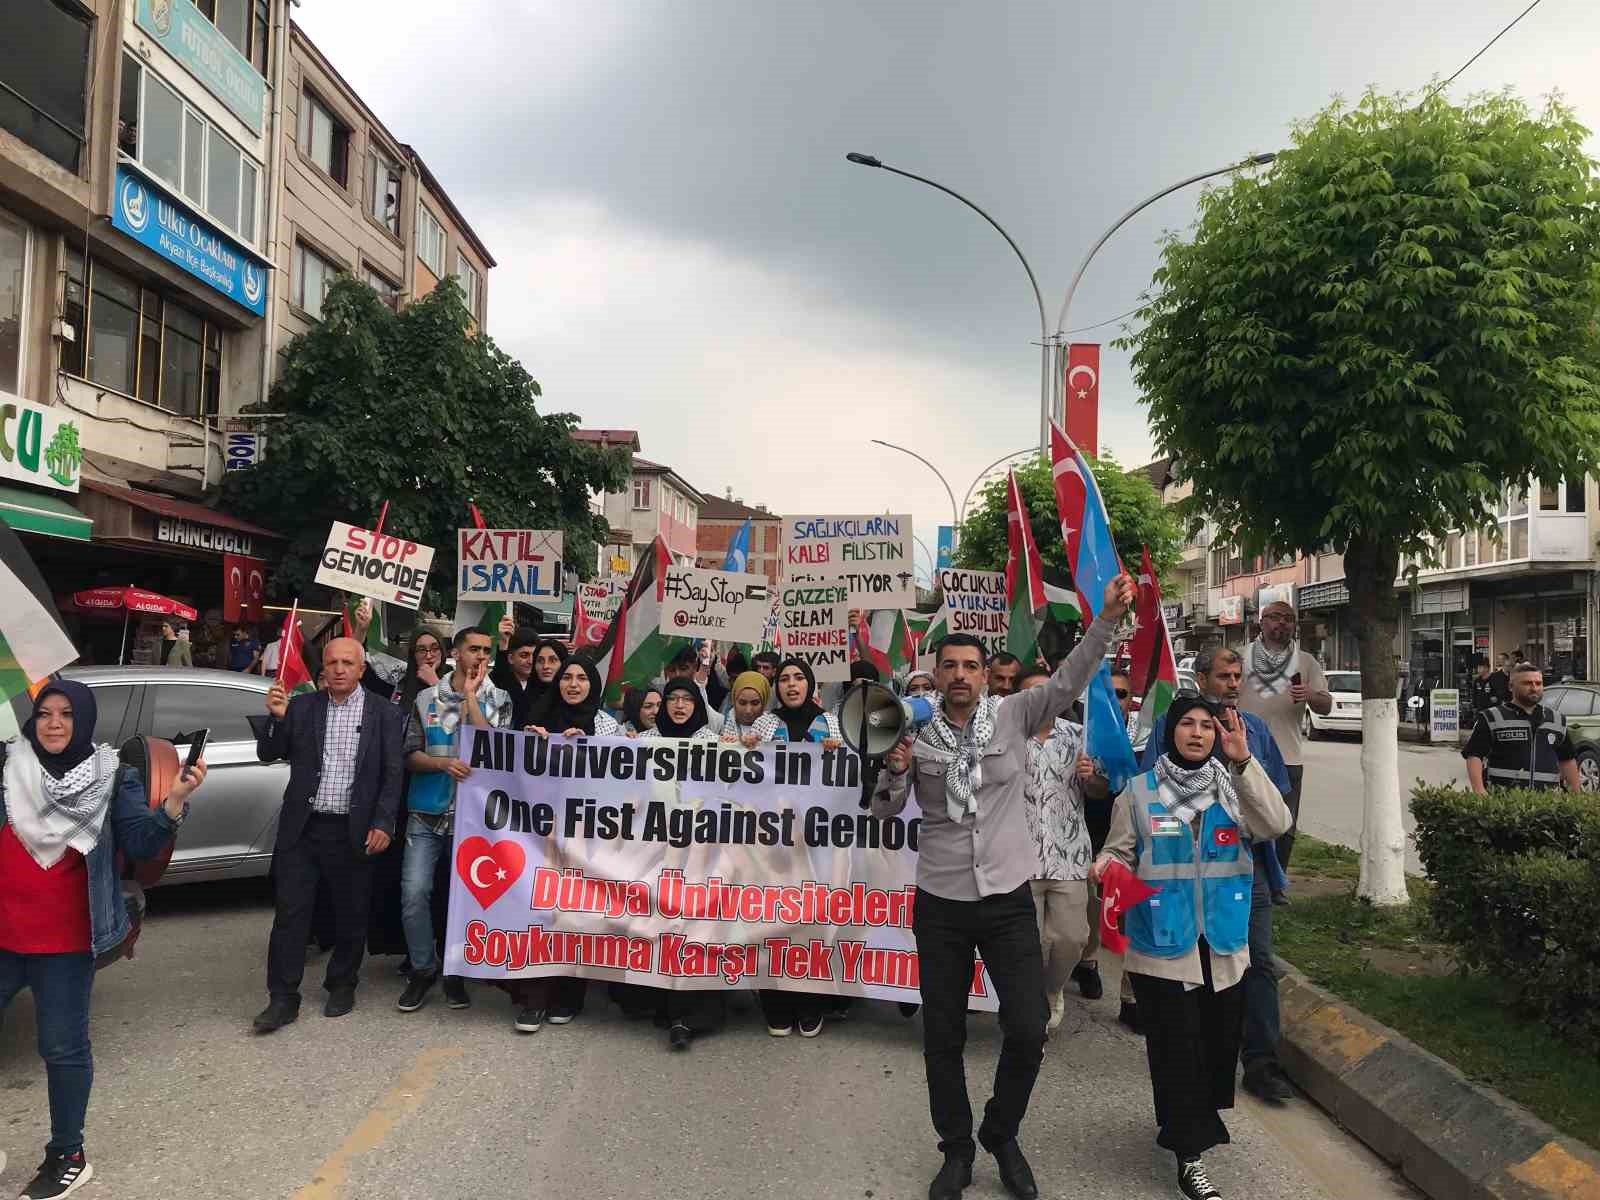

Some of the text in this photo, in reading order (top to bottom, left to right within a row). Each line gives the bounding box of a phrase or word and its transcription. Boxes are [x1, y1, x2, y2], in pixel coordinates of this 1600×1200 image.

[346, 527, 417, 563] STOP
[794, 517, 899, 539] SAĞLIKÇILARIN
[321, 547, 427, 592] GENOCIDE
[789, 542, 830, 565] KALBİ
[838, 573, 893, 593] TIYOR
[784, 608, 833, 628] SELAM
[471, 729, 861, 787] All Universities in th
[484, 790, 554, 836] One
[564, 798, 635, 841] Fist
[642, 802, 795, 848] Against
[530, 866, 651, 919] Dünya
[464, 919, 654, 972] Soykırıma
[657, 933, 760, 986] Karşı
[765, 937, 835, 981] Tek
